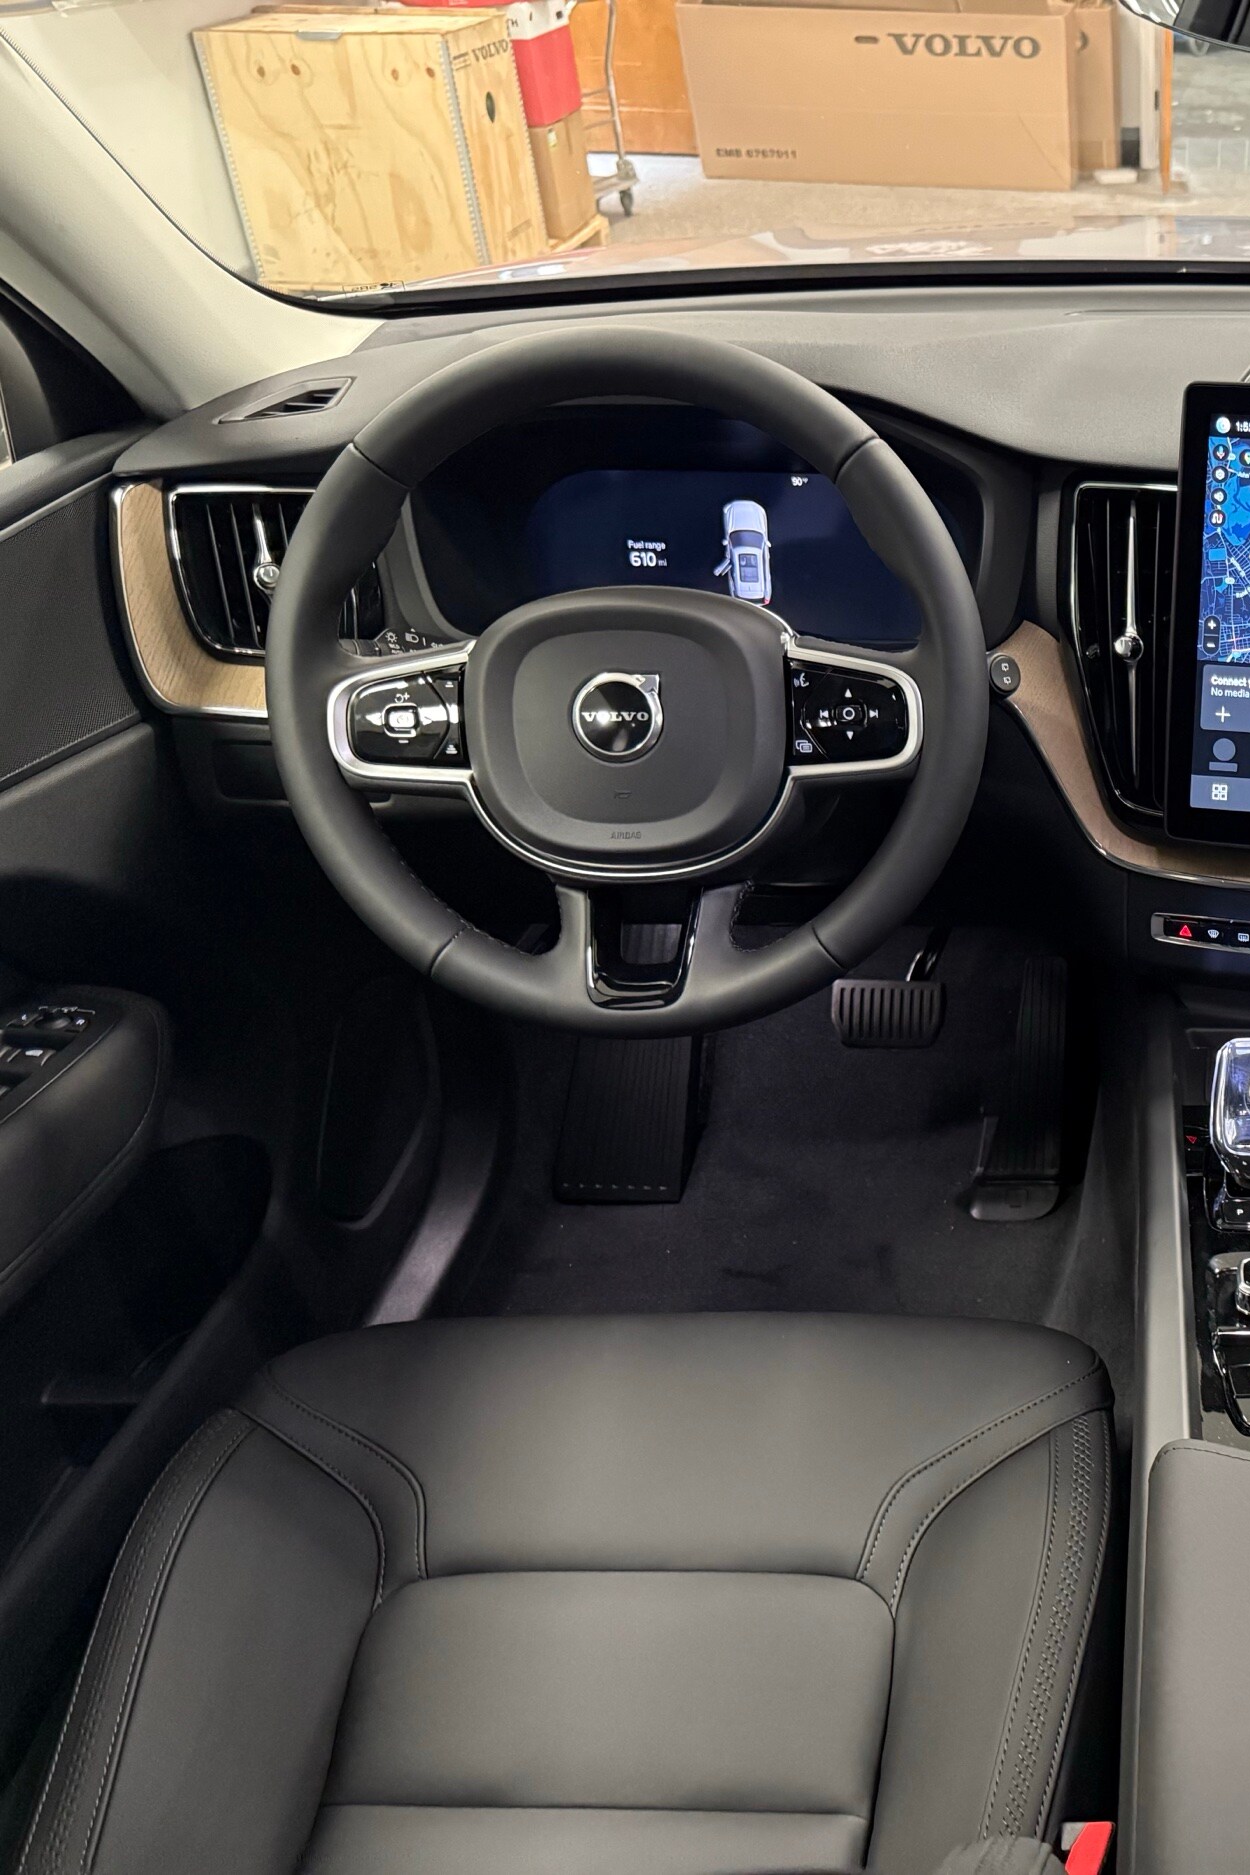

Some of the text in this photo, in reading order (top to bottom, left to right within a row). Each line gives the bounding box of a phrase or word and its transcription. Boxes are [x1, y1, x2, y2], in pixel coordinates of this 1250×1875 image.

[472, 38, 509, 62] VOLVO
[887, 33, 1041, 59] VOLVO
[627, 539, 666, 552] Fuel range
[629, 551, 657, 567] 610
[1210, 675, 1247, 687] Connect
[1210, 686, 1223, 696] No
[1224, 688, 1250, 699] media
[581, 711, 650, 722] VOLVO
